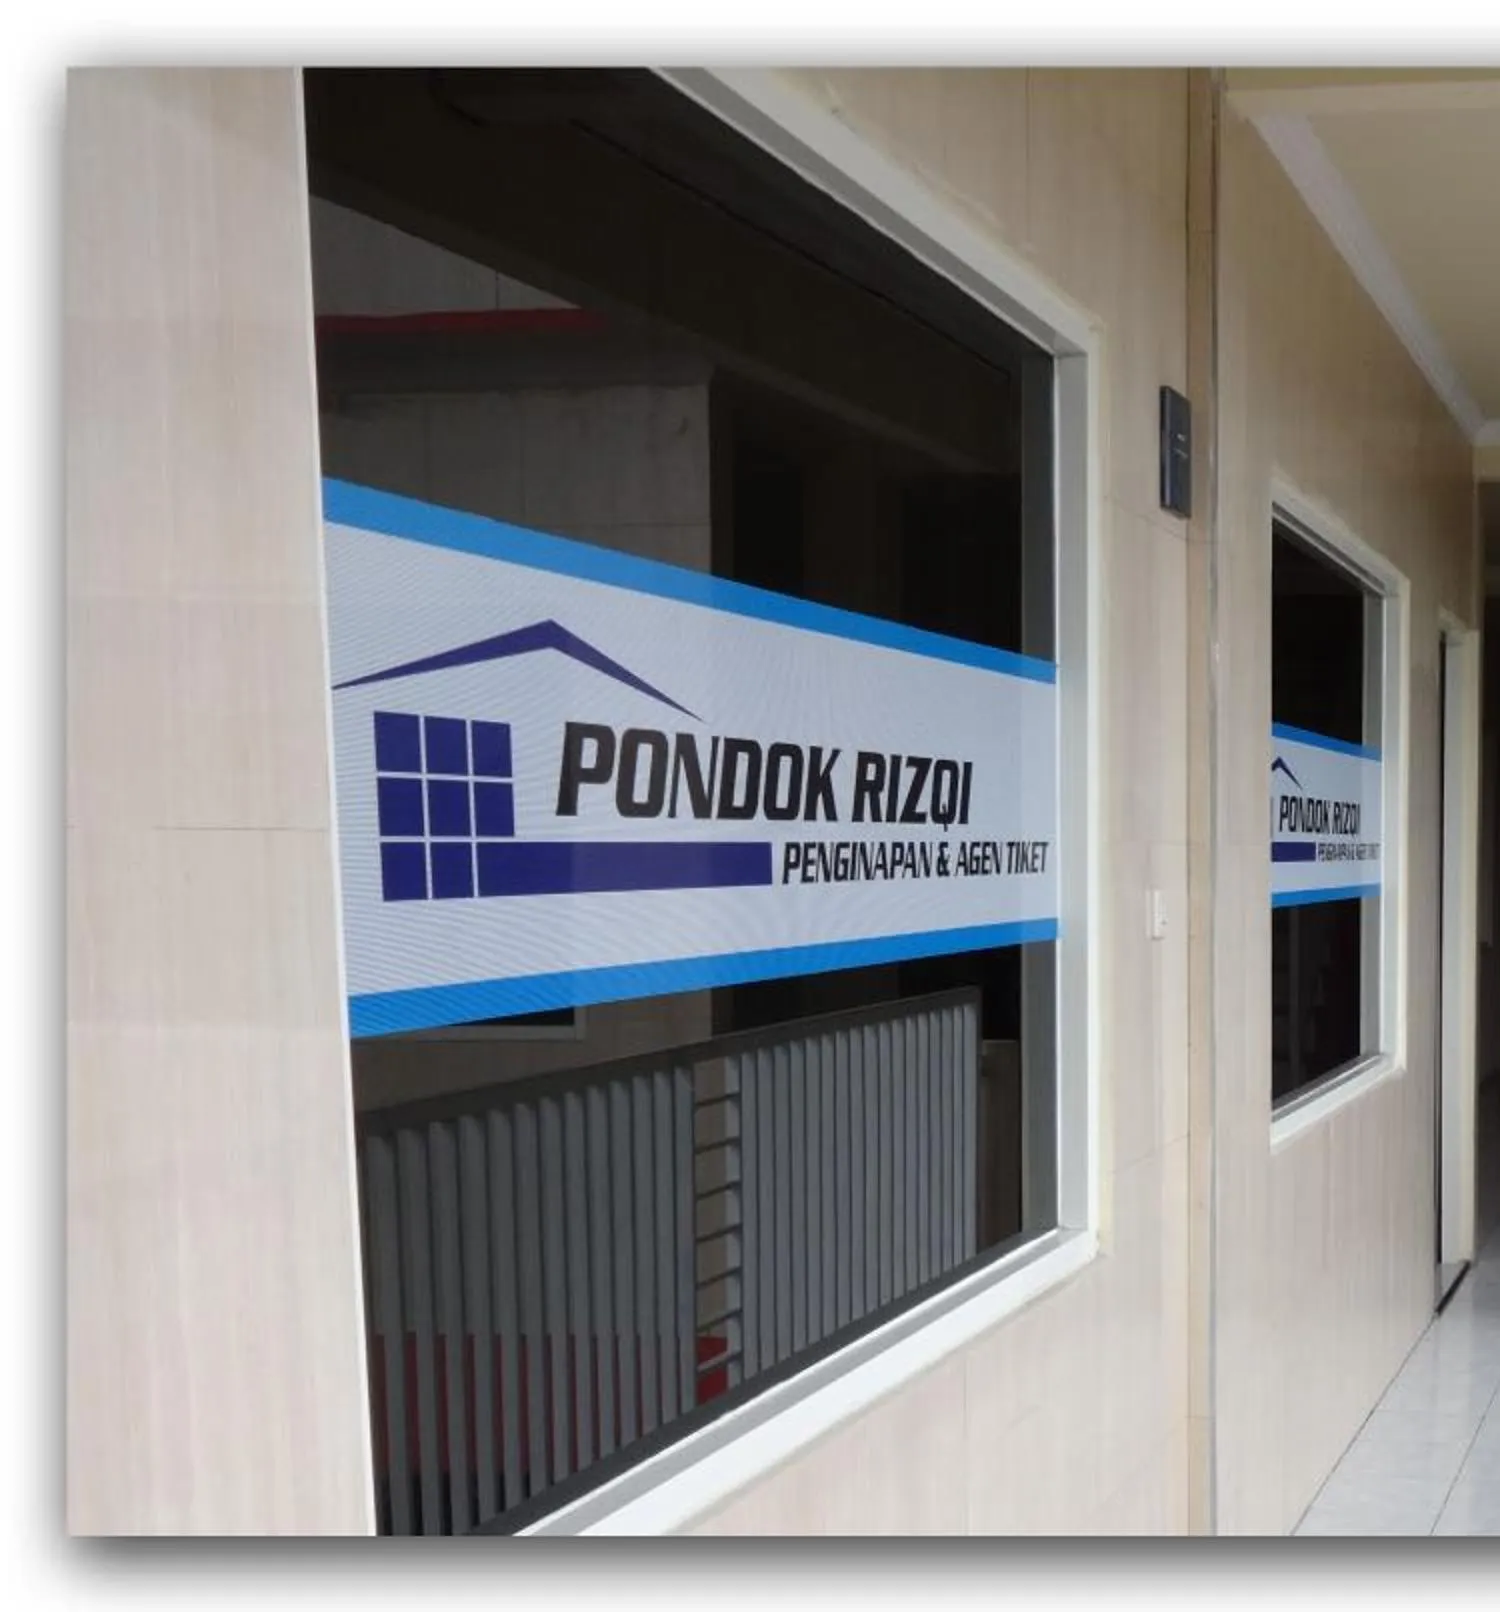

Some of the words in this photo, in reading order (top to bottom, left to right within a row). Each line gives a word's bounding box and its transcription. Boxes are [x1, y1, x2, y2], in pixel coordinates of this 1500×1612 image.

[556, 721, 842, 822] PONDOK
[851, 751, 973, 832] RIZQI
[1279, 795, 1331, 834] PONDOK
[781, 841, 934, 885] PENGINAPAN
[936, 841, 950, 877] &
[954, 841, 1004, 877] AGEN
[1006, 841, 1050, 875] TIKET
